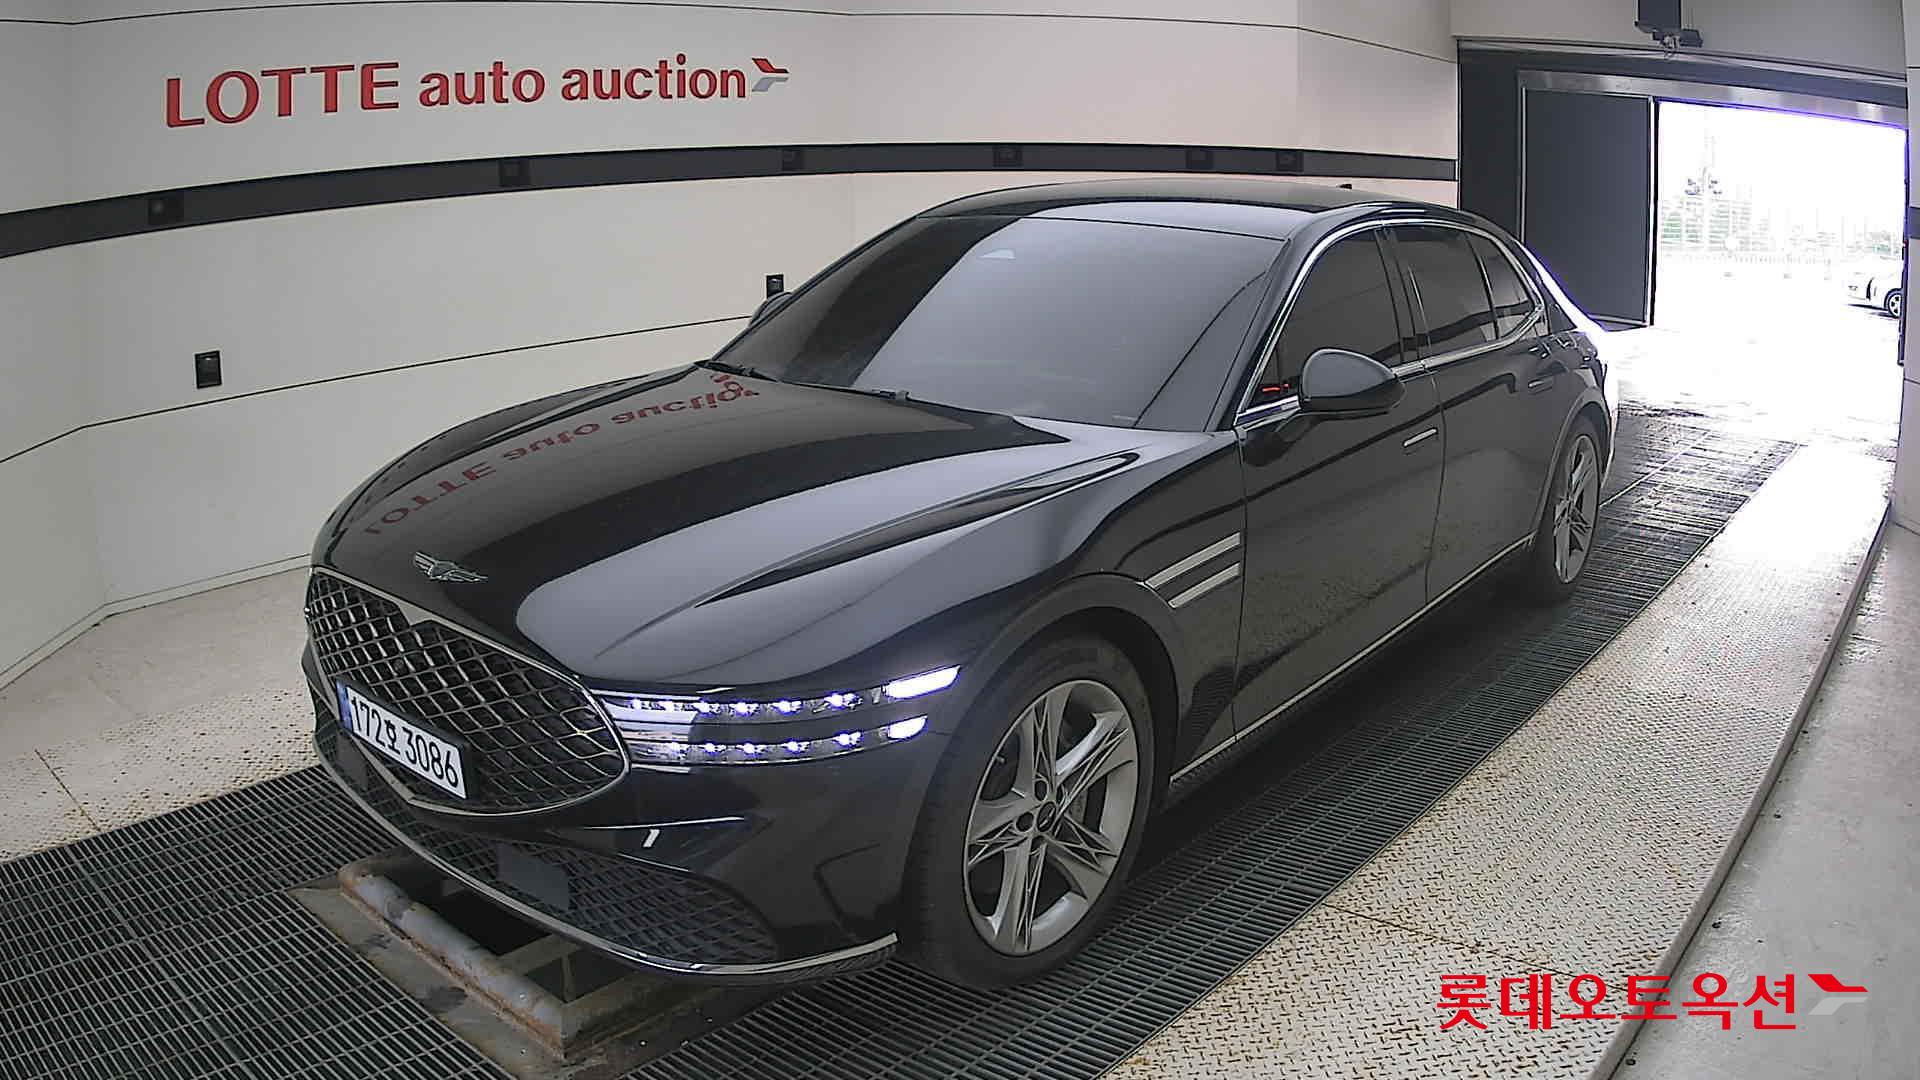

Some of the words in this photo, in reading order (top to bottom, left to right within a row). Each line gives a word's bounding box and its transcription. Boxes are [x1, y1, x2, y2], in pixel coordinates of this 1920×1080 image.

[166, 62, 399, 128] LOTTE
[419, 61, 546, 106] auto
[560, 54, 747, 101] auction
[402, 726, 459, 788] 3086
